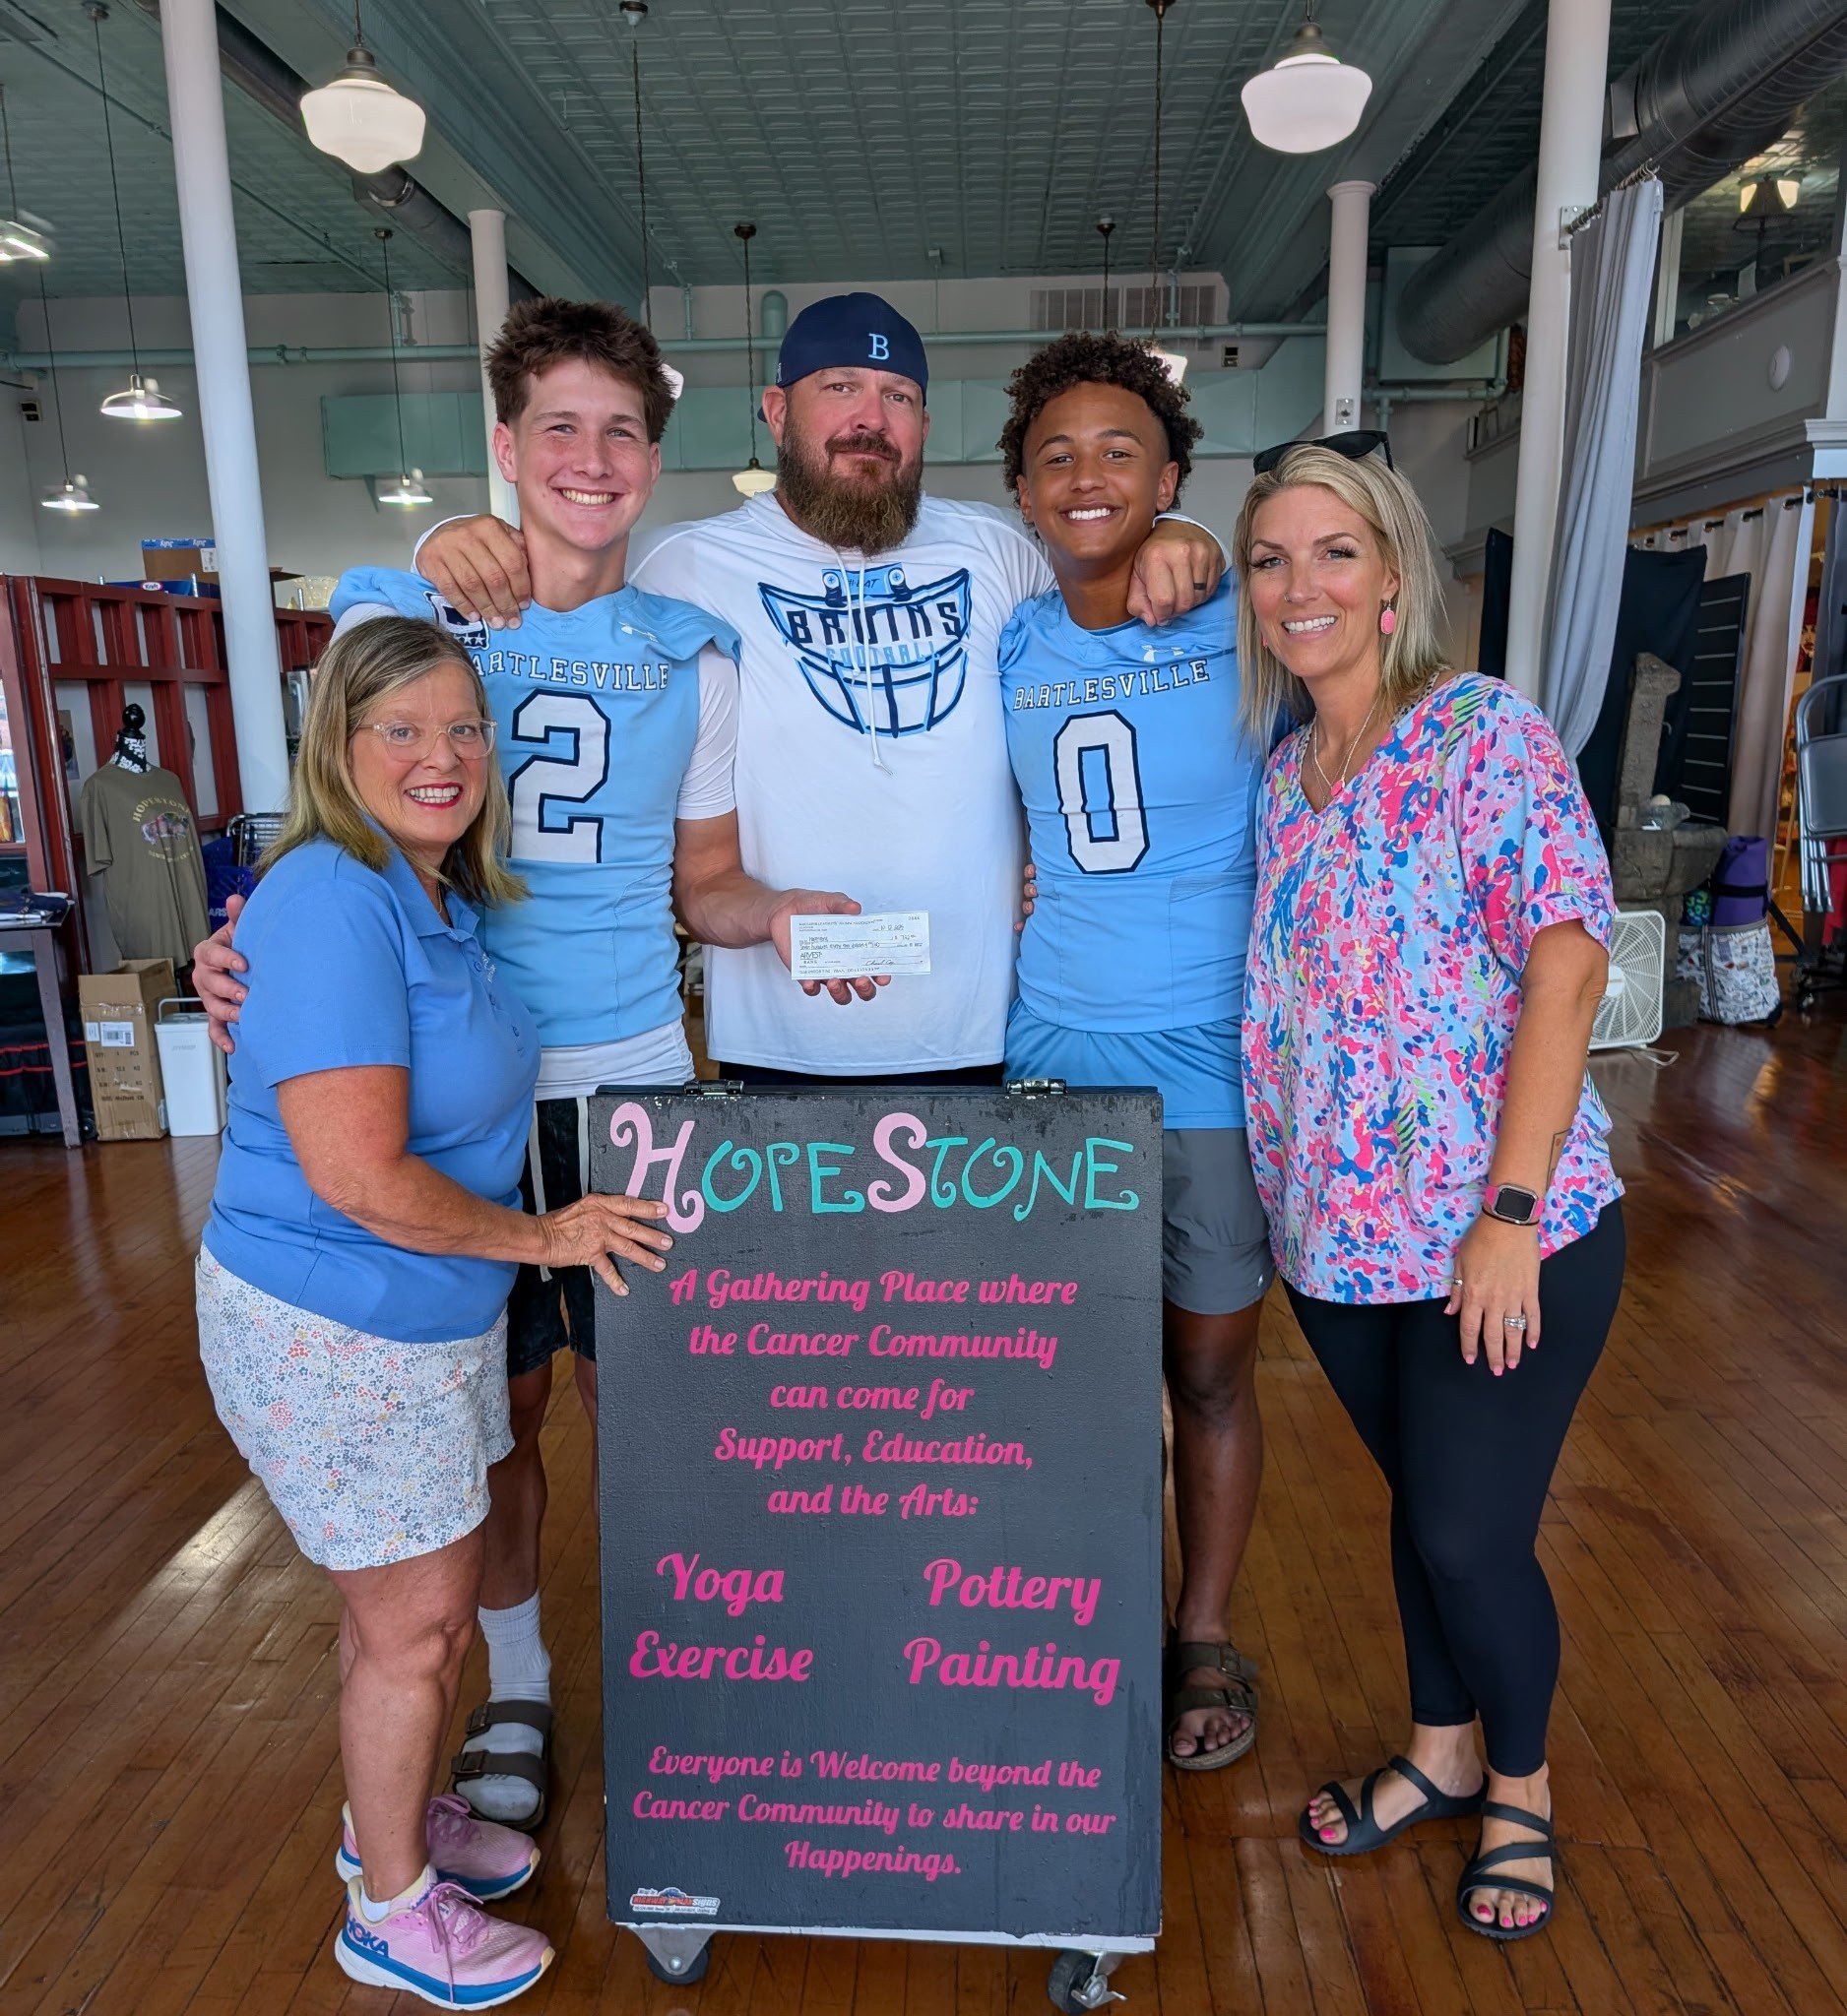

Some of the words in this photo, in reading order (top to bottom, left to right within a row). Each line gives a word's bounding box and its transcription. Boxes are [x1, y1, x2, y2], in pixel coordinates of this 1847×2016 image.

[868, 333, 890, 360] B
[787, 601, 964, 645] BRUINS
[473, 651, 670, 691] ARTLESVILLE
[1013, 659, 1210, 711] BARTLESVILLE
[506, 688, 611, 863] 2
[1053, 709, 1150, 874] 0
[209, 908, 227, 916] ARS
[609, 1102, 1139, 1233] HOPESTONE
[669, 1270, 697, 1304] A
[707, 1270, 870, 1311] Gathering
[880, 1271, 969, 1302] Place
[979, 1274, 1077, 1304] where
[690, 1326, 737, 1354] the
[747, 1324, 859, 1355] Cancer
[869, 1325, 1057, 1368] Community
[771, 1386, 827, 1408] can
[837, 1387, 919, 1410] come
[921, 1378, 974, 1419] for
[715, 1428, 851, 1469] Support,
[862, 1430, 1032, 1468] Education,
[768, 1484, 833, 1513] and
[841, 1485, 888, 1515] the
[899, 1484, 978, 1519] Arts:
[657, 1553, 784, 1616] Yoga
[924, 1559, 1101, 1625] Pottery
[630, 1631, 812, 1680] Exercise
[904, 1638, 1120, 1705] Painting
[650, 1746, 774, 1783] Everyone
[781, 1751, 801, 1777] is
[810, 1751, 940, 1782] Welcome
[948, 1758, 1051, 1792] beyond
[1058, 1762, 1101, 1787] the
[634, 1793, 729, 1819] Cancer
[738, 1795, 899, 1834] Community
[908, 1803, 933, 1827] to
[943, 1804, 1023, 1830] share
[1032, 1805, 1057, 1831] in
[1066, 1814, 1115, 1833] our
[786, 1841, 960, 1881] Happenings.
